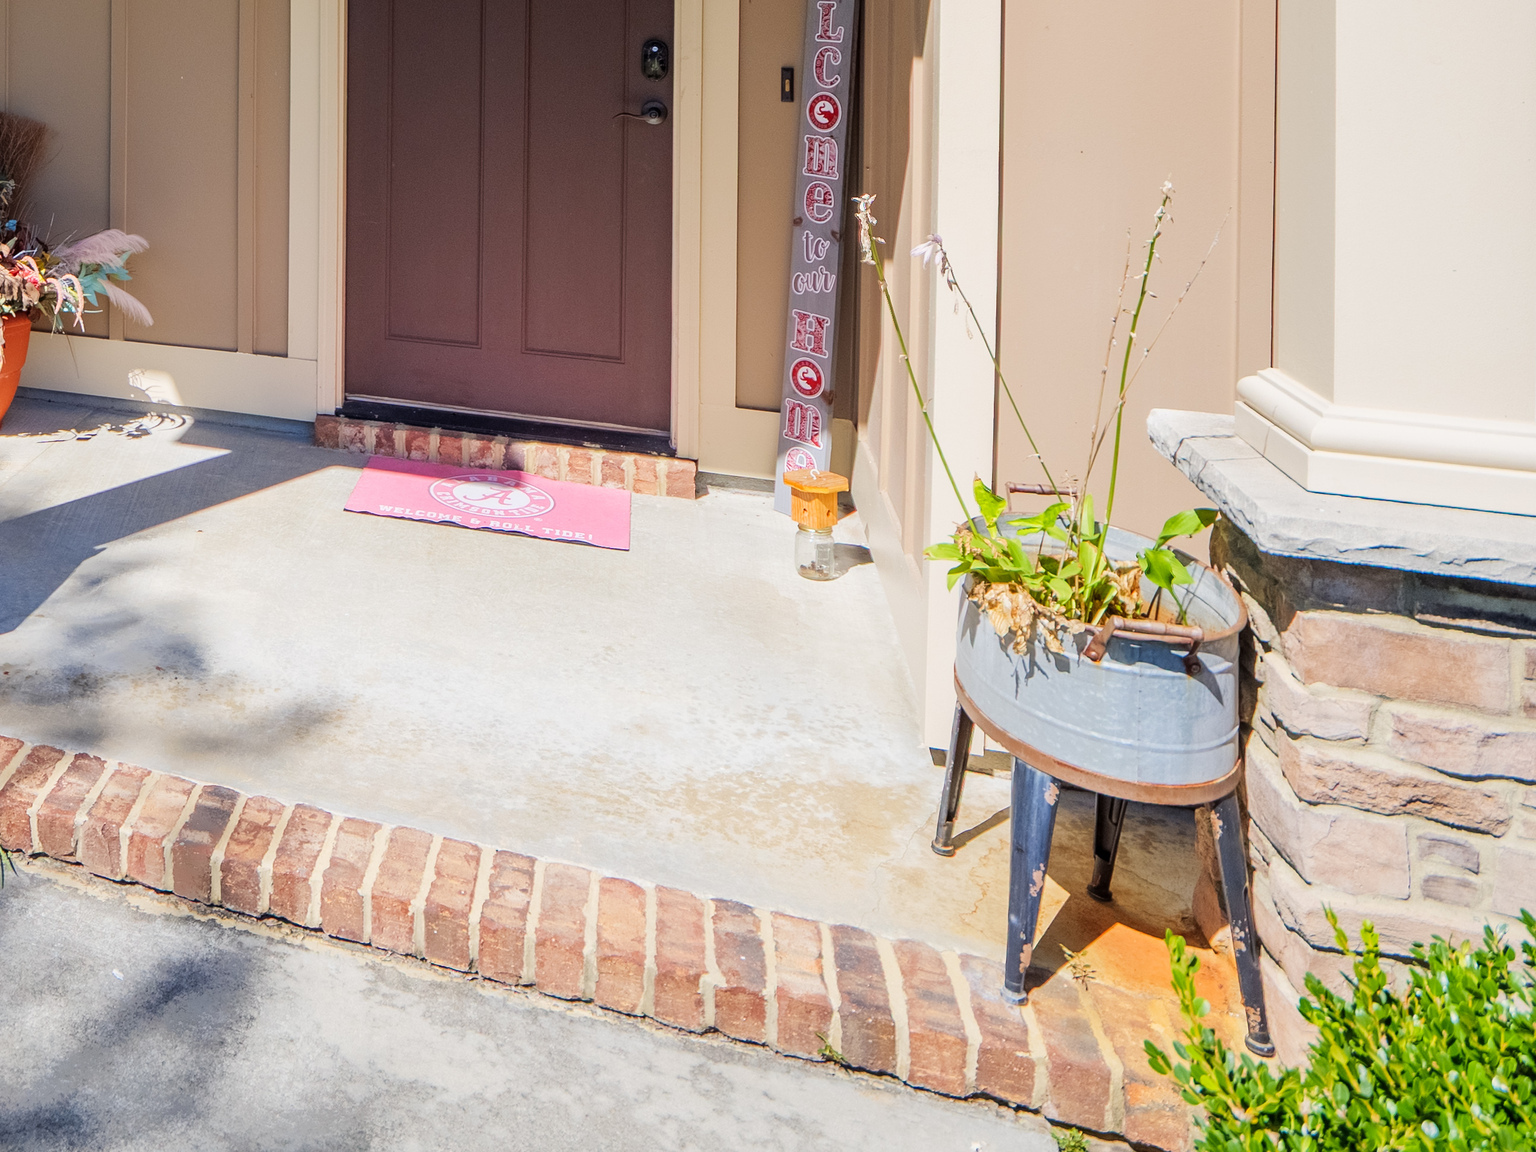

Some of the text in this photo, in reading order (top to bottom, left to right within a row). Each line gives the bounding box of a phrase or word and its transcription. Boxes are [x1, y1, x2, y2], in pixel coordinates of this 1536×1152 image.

[802, 230, 831, 263] to
[792, 266, 836, 295] our
[437, 491, 546, 516] CRIMSON TIDE
[379, 504, 594, 541] WELCOME & ROLL TIDE!
